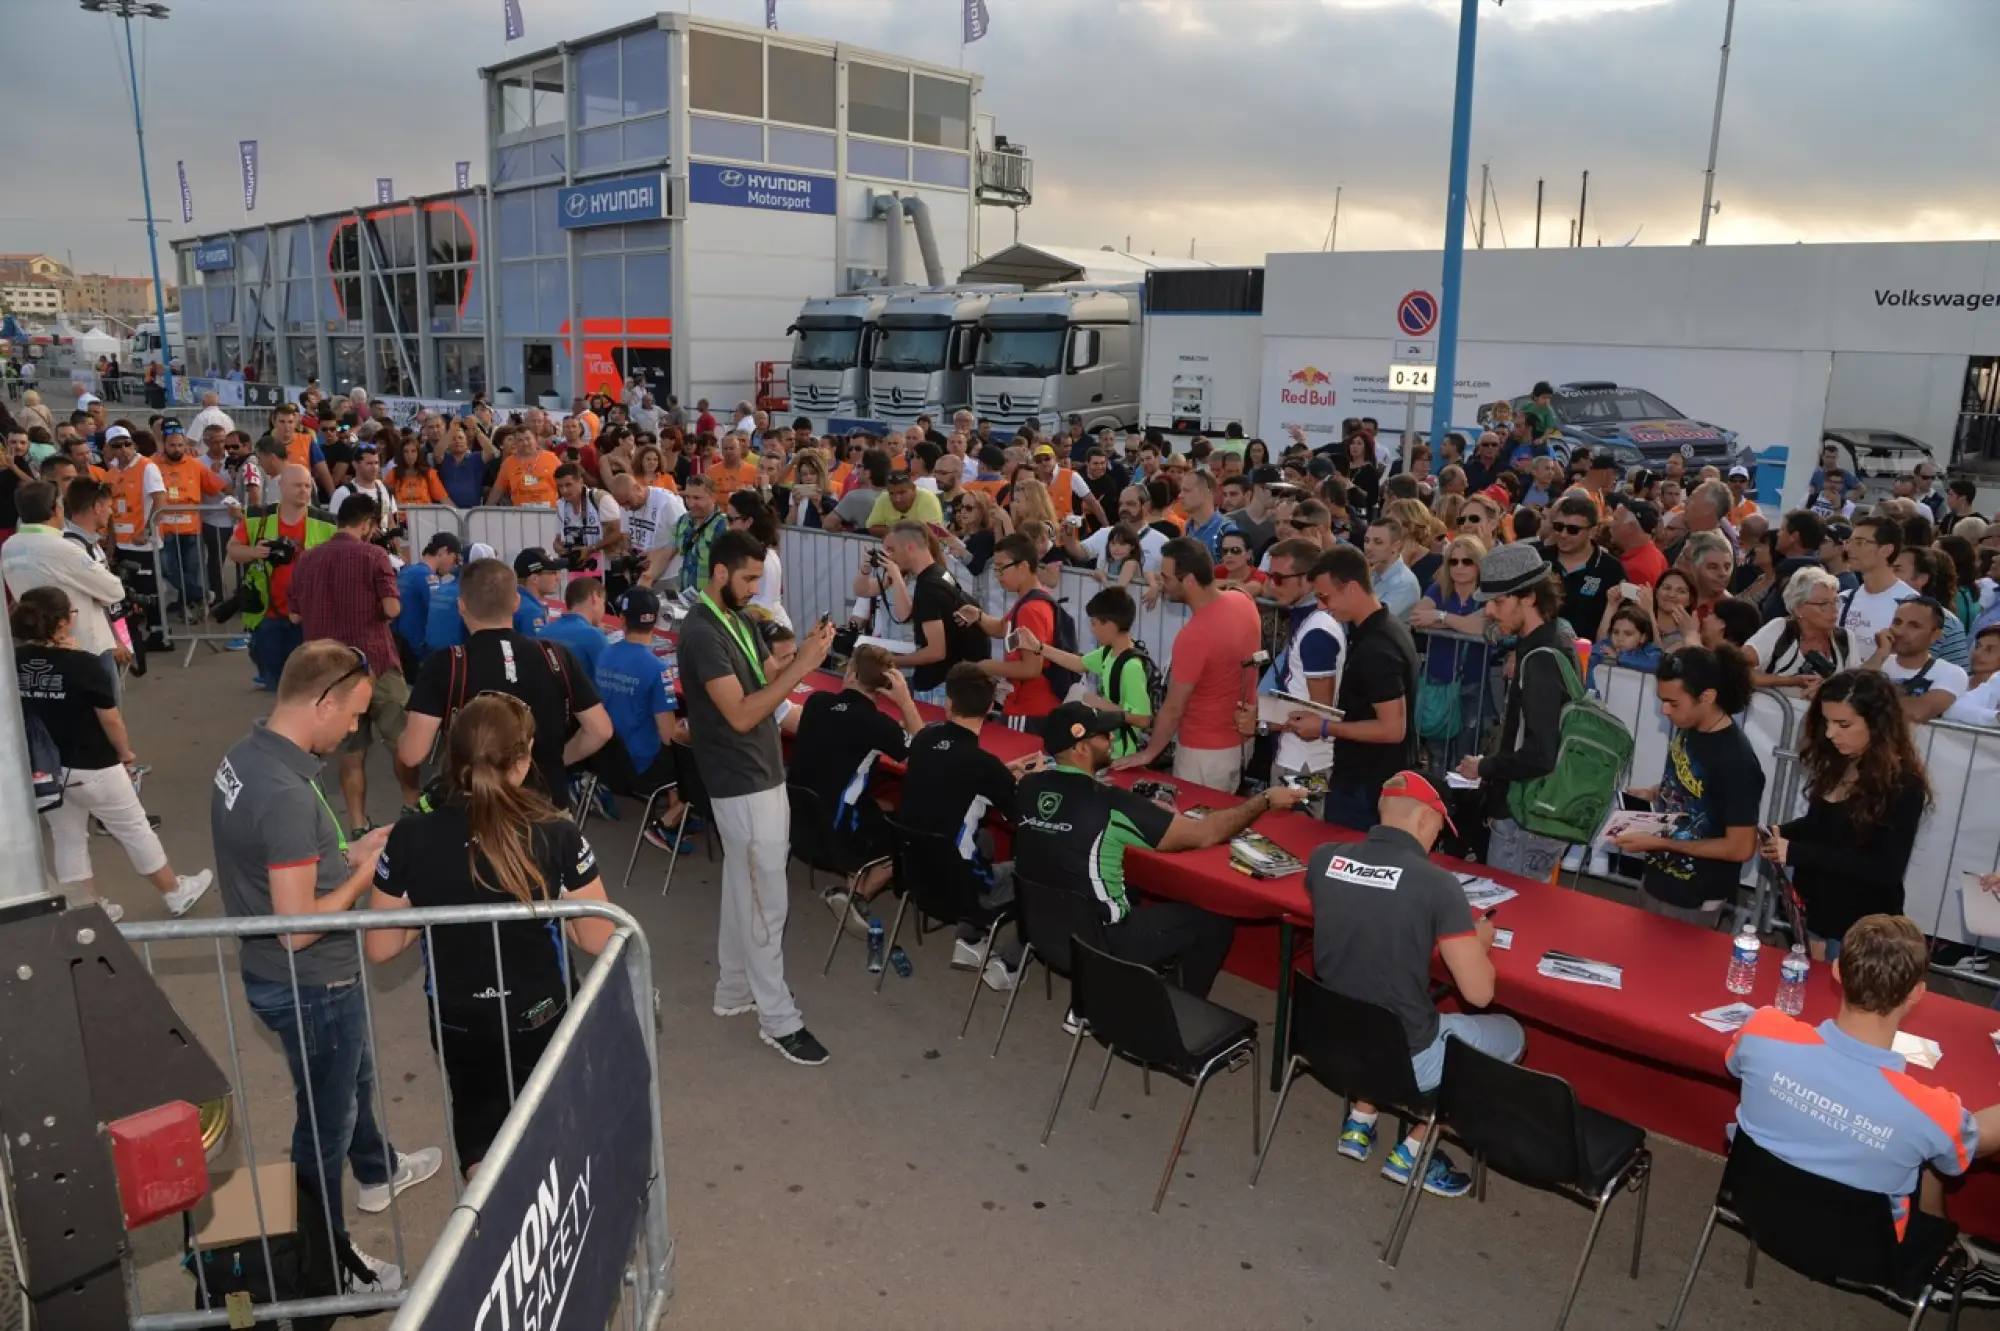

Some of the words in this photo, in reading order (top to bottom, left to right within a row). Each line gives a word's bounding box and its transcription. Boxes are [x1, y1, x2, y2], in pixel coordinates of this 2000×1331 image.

[748, 174, 811, 192] HYUNDAI
[591, 186, 653, 213] HYUNDAI
[748, 190, 810, 209] Motorsport
[1281, 388, 1308, 403] Red
[1310, 390, 1336, 406] Bull
[1772, 1071, 1849, 1119] HYUNDAI
[1852, 1114, 1895, 1141] Shell
[1769, 1086, 1808, 1113] WORLD
[1810, 1110, 1849, 1132] RALLY
[1850, 1128, 1887, 1151] TEAM
